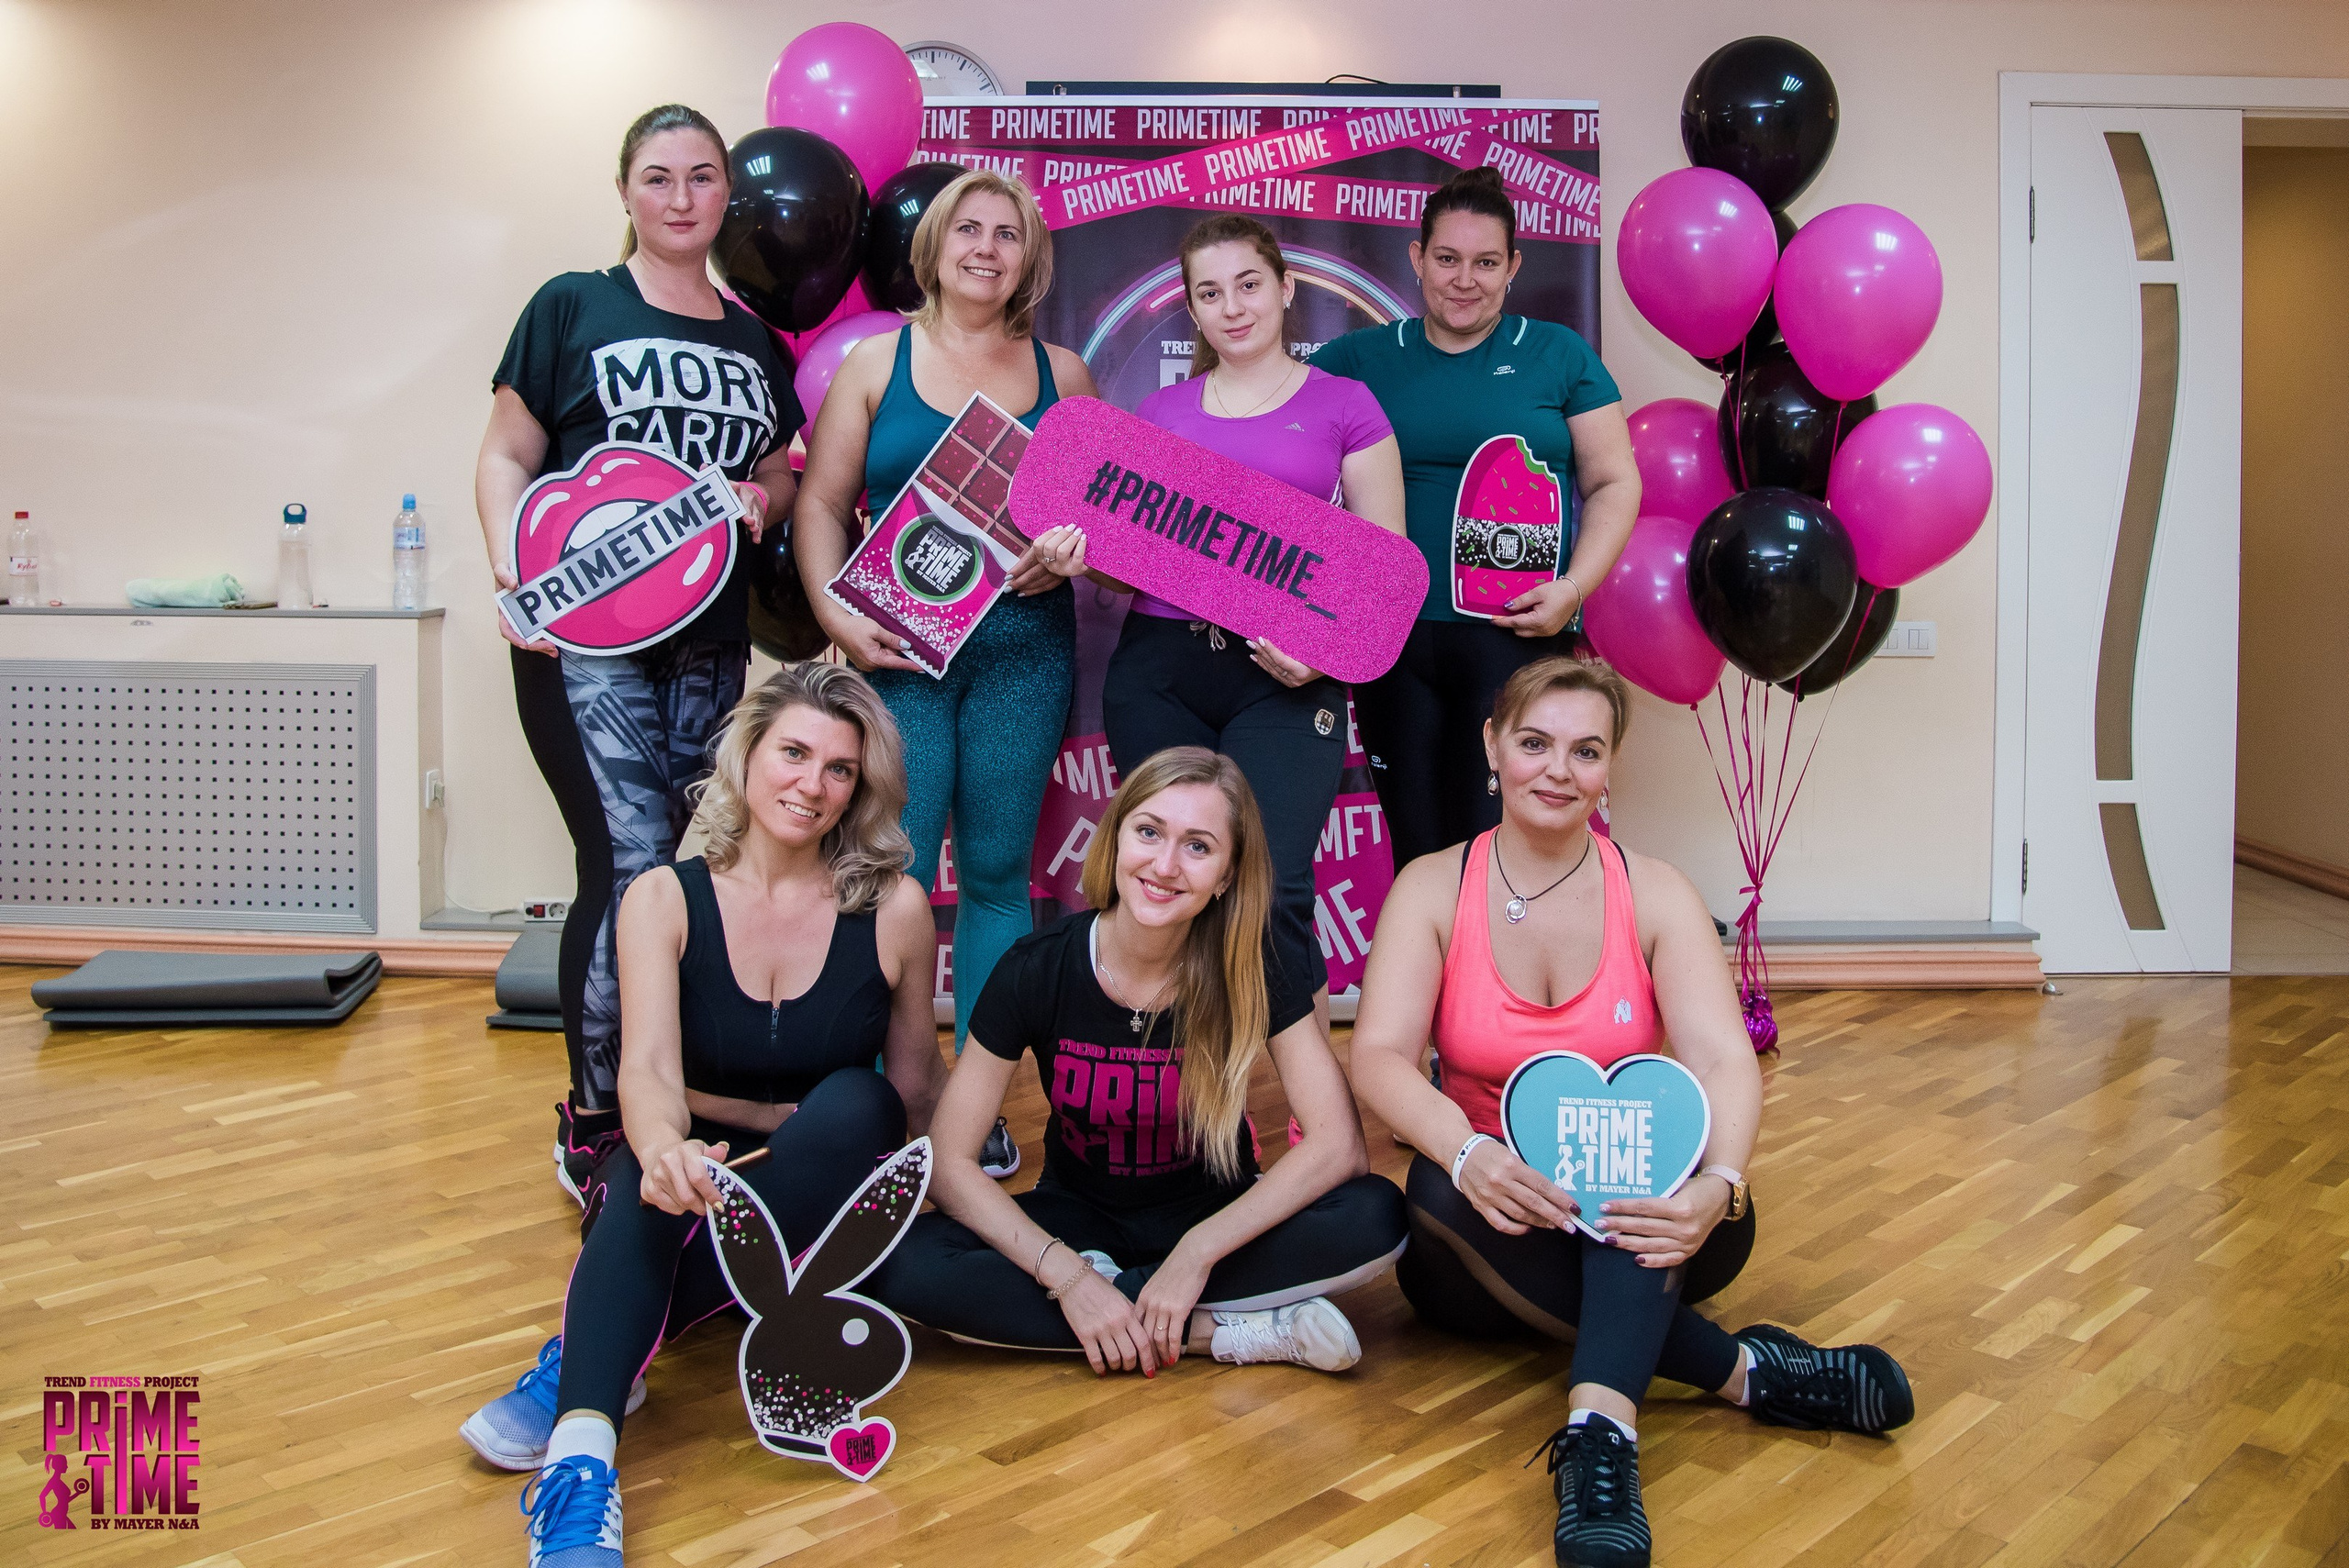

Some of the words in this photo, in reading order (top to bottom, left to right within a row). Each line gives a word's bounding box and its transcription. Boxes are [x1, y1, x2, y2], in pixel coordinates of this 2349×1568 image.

[991, 108, 1117, 139] PRIMETIME
[1137, 108, 1263, 140] PRIMETIME
[1062, 160, 1190, 220] PRIMETIME
[1204, 127, 1331, 185] PRIMETIME
[516, 483, 726, 627] PRIMETIME
[1083, 461, 1338, 620] #PRIMETIME_
[1058, 1038, 1107, 1060] TREND
[1108, 1046, 1172, 1062] FITNESS
[1558, 1096, 1585, 1106] TREND
[1586, 1097, 1617, 1107] FITNESS
[1618, 1099, 1653, 1109] PROJECT
[1581, 1143, 1653, 1186] TIME
[1585, 1184, 1598, 1193] BY
[1599, 1184, 1631, 1195] MAYER
[1631, 1186, 1653, 1195] N&A
